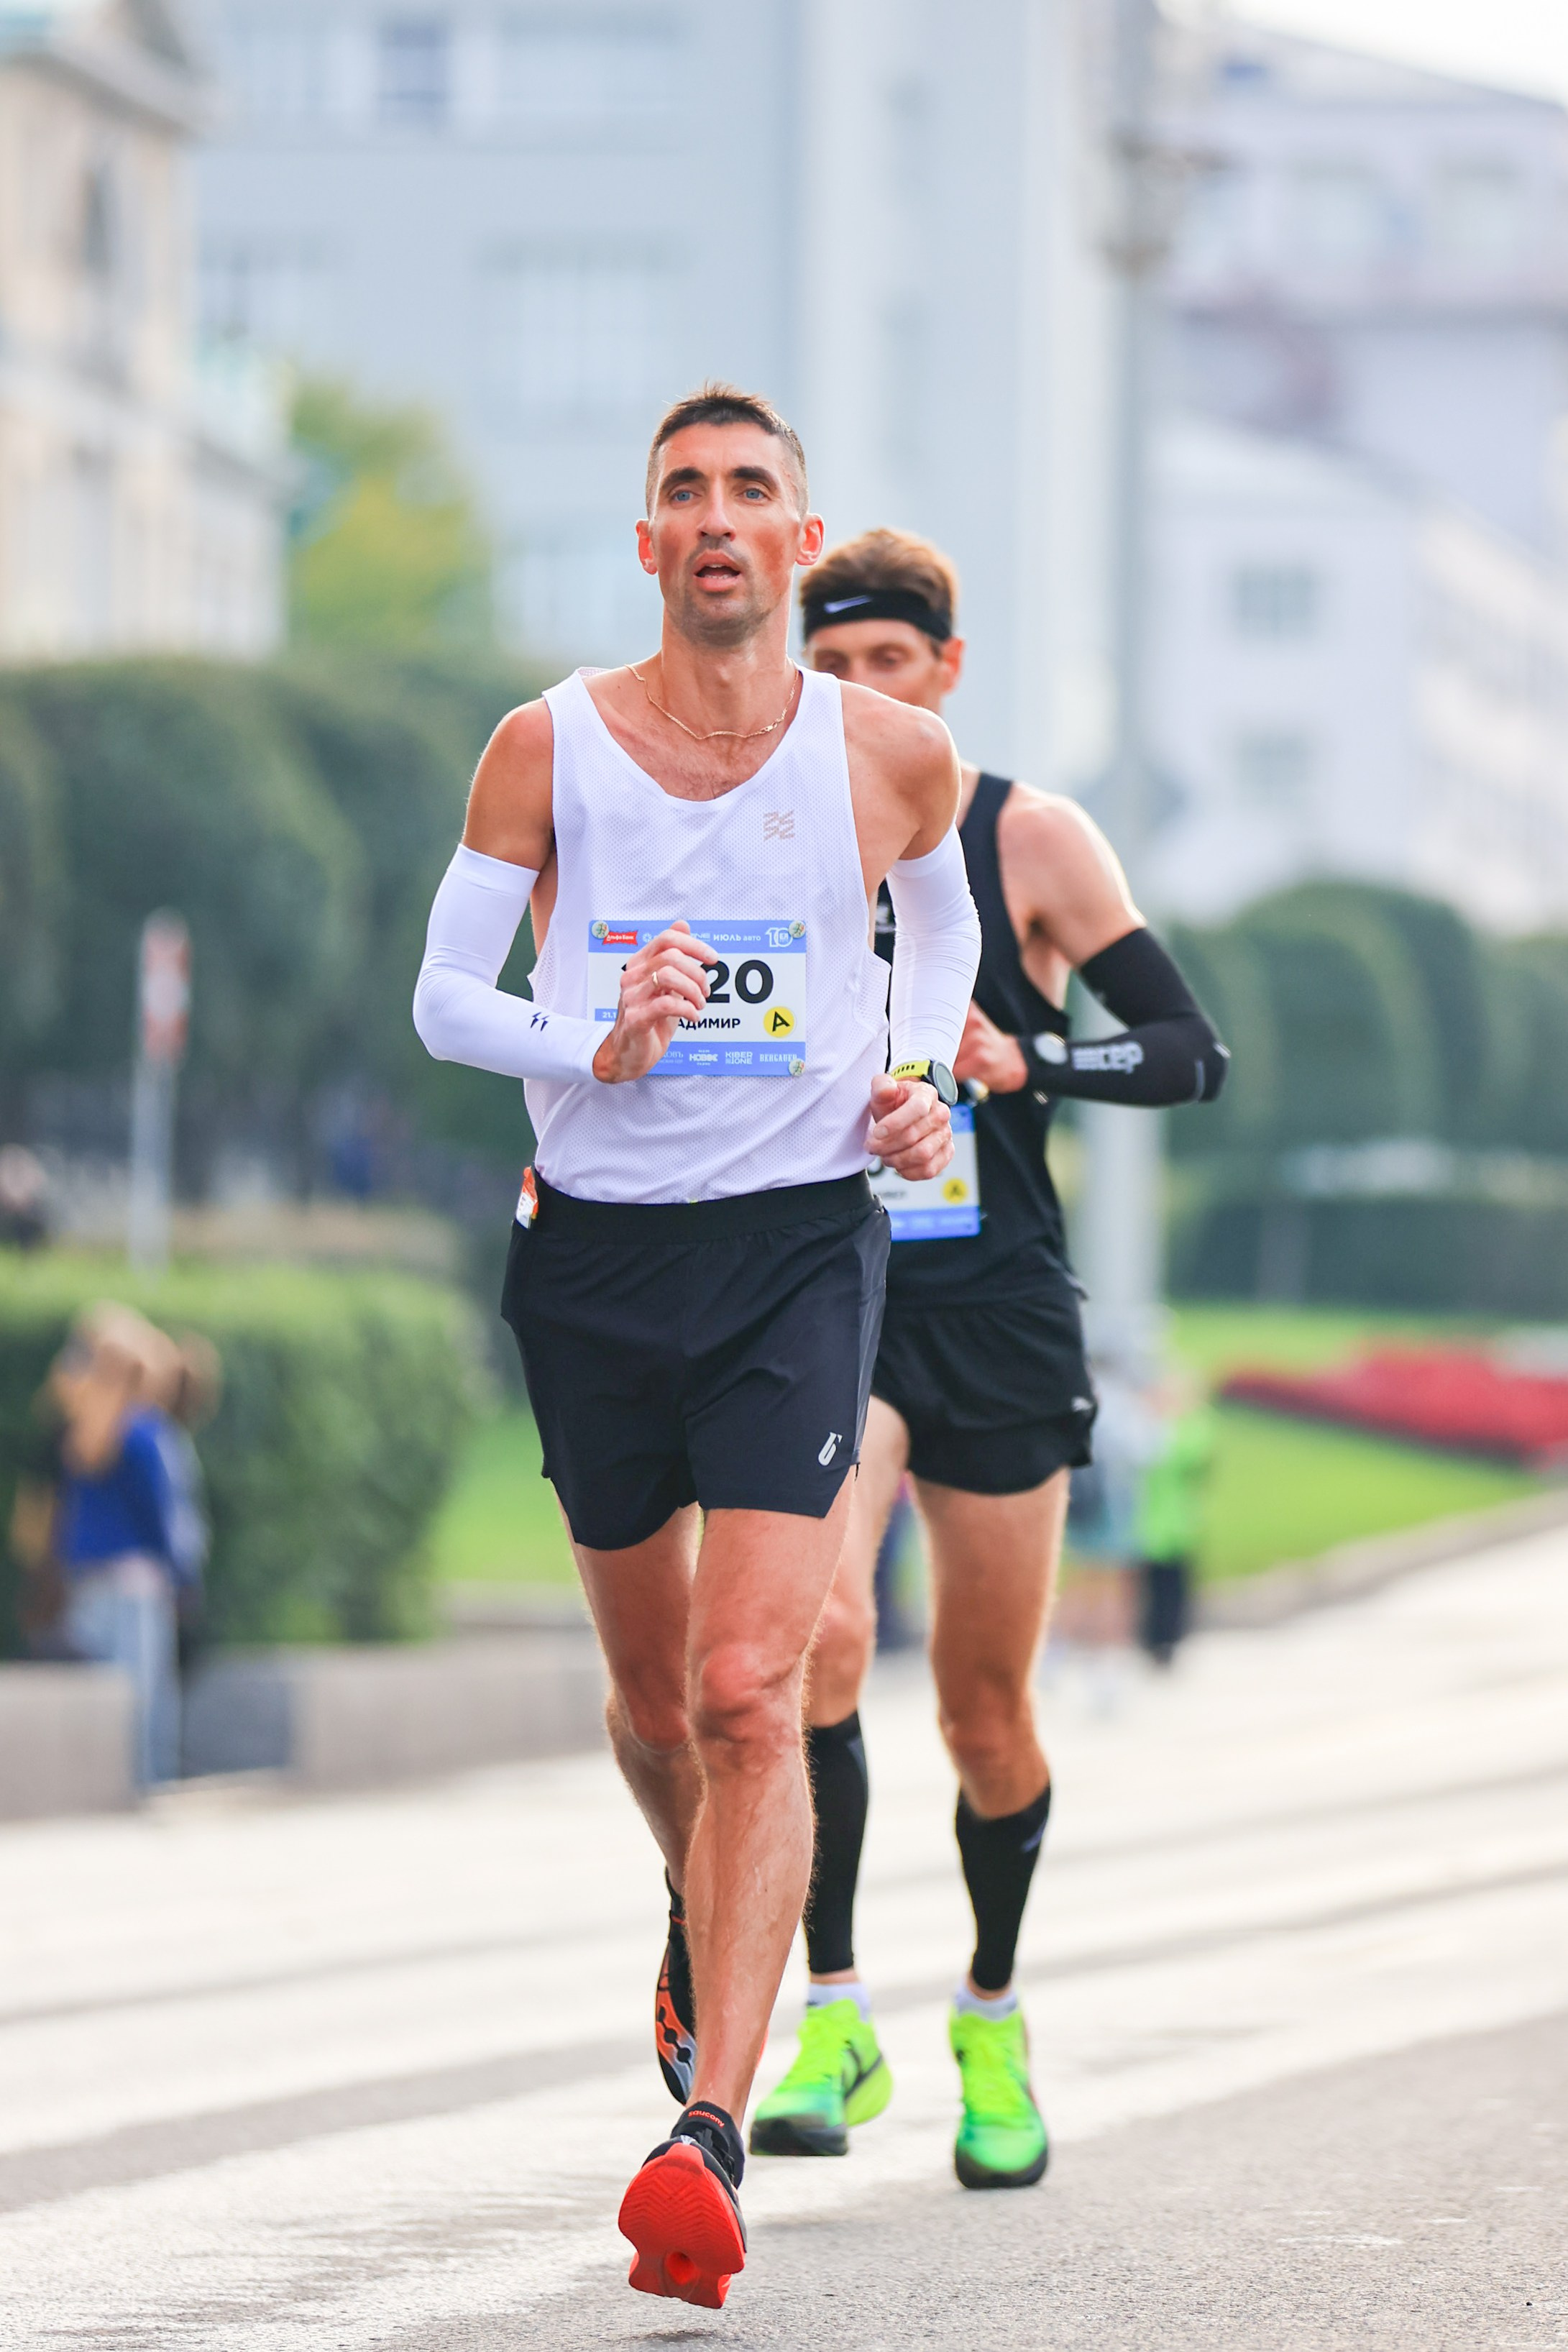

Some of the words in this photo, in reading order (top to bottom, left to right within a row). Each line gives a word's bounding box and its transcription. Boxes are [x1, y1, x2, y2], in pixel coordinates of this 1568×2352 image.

[713, 933, 741, 942] ИЮЛЬ
[678, 1018, 741, 1030] АДИМИР
[688, 2109, 725, 2128] saucony
